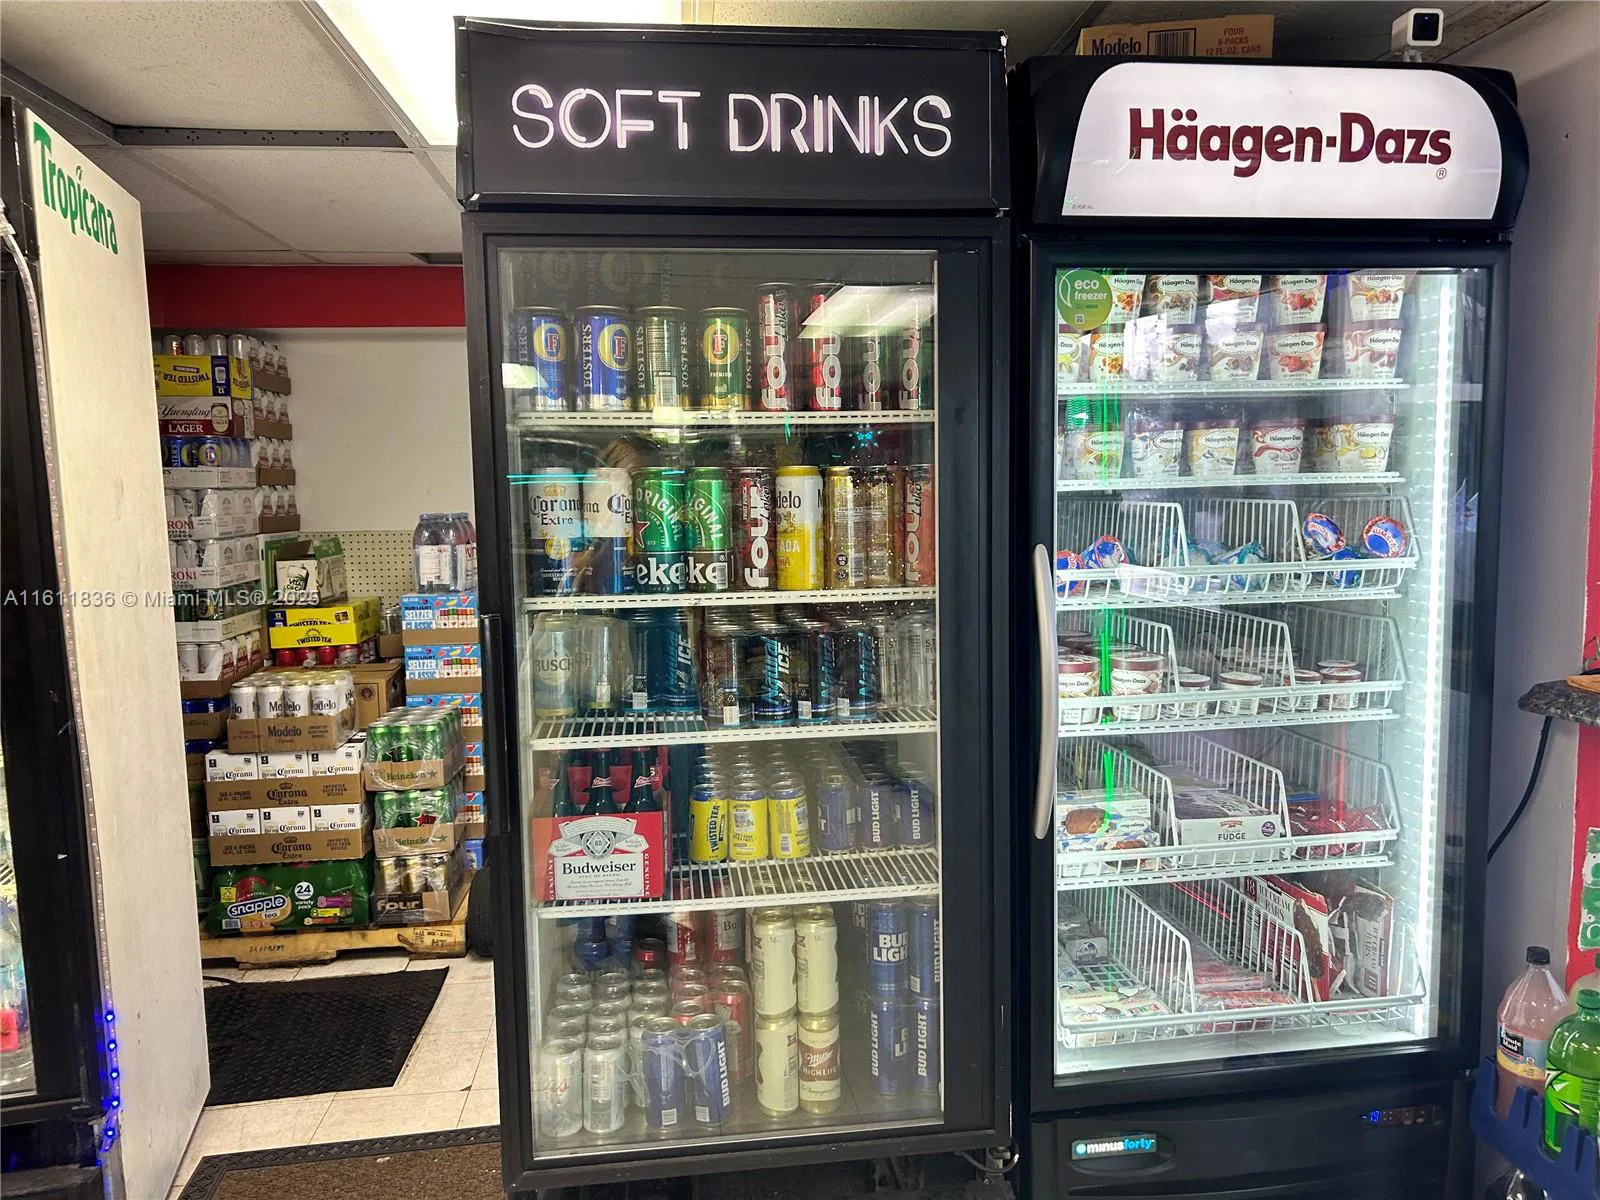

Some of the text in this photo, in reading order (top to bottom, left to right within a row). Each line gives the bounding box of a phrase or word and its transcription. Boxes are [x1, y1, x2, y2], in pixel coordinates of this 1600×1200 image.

[1223, 27, 1245, 37] FOUR
[1091, 38, 1142, 56] Modelo
[511, 83, 952, 157] SOFT DRINKS
[1129, 107, 1452, 178] Häagen-Dazs
[33, 121, 119, 255] Tropicana
[1074, 279, 1099, 290] eco
[1074, 291, 1108, 301] freezer
[614, 336, 626, 359] F
[581, 323, 593, 389] FOSTER'S
[681, 321, 689, 389] FOSTER'S
[159, 403, 211, 418] Yuengling
[168, 424, 204, 433] LAGER
[167, 520, 195, 530] RONI
[171, 571, 197, 580] RONI
[405, 610, 433, 620] SELTZER
[408, 659, 437, 670] SELTZER
[535, 655, 574, 672] BUSCH
[777, 641, 790, 675] ICE
[312, 699, 336, 711] odelo
[268, 725, 302, 737] Modelo
[225, 771, 253, 779] Corona
[277, 767, 304, 777] Corona
[327, 765, 354, 774] Corona
[266, 789, 309, 801] Corona
[911, 789, 920, 817] LIGHT
[871, 791, 881, 843] BUD LIGHT
[228, 827, 256, 835] Corona
[279, 824, 306, 833] Corona
[329, 821, 356, 830] Corona
[708, 805, 721, 853] TWISTED TEA
[1217, 833, 1246, 841] FUDGE
[271, 842, 312, 855] Corona
[282, 852, 303, 860] Extra
[562, 860, 637, 875] Budweiser
[296, 884, 312, 894] 24
[1246, 879, 1256, 897] 18
[231, 897, 284, 917] snapple
[264, 911, 278, 919] tea
[873, 948, 908, 963] LIGH
[870, 1011, 879, 1077] BUD LIGHT
[918, 1012, 928, 1077] BUD LIGHT
[717, 1041, 730, 1107] BUD LIGHT
[1086, 1138, 1153, 1154] minusforty
